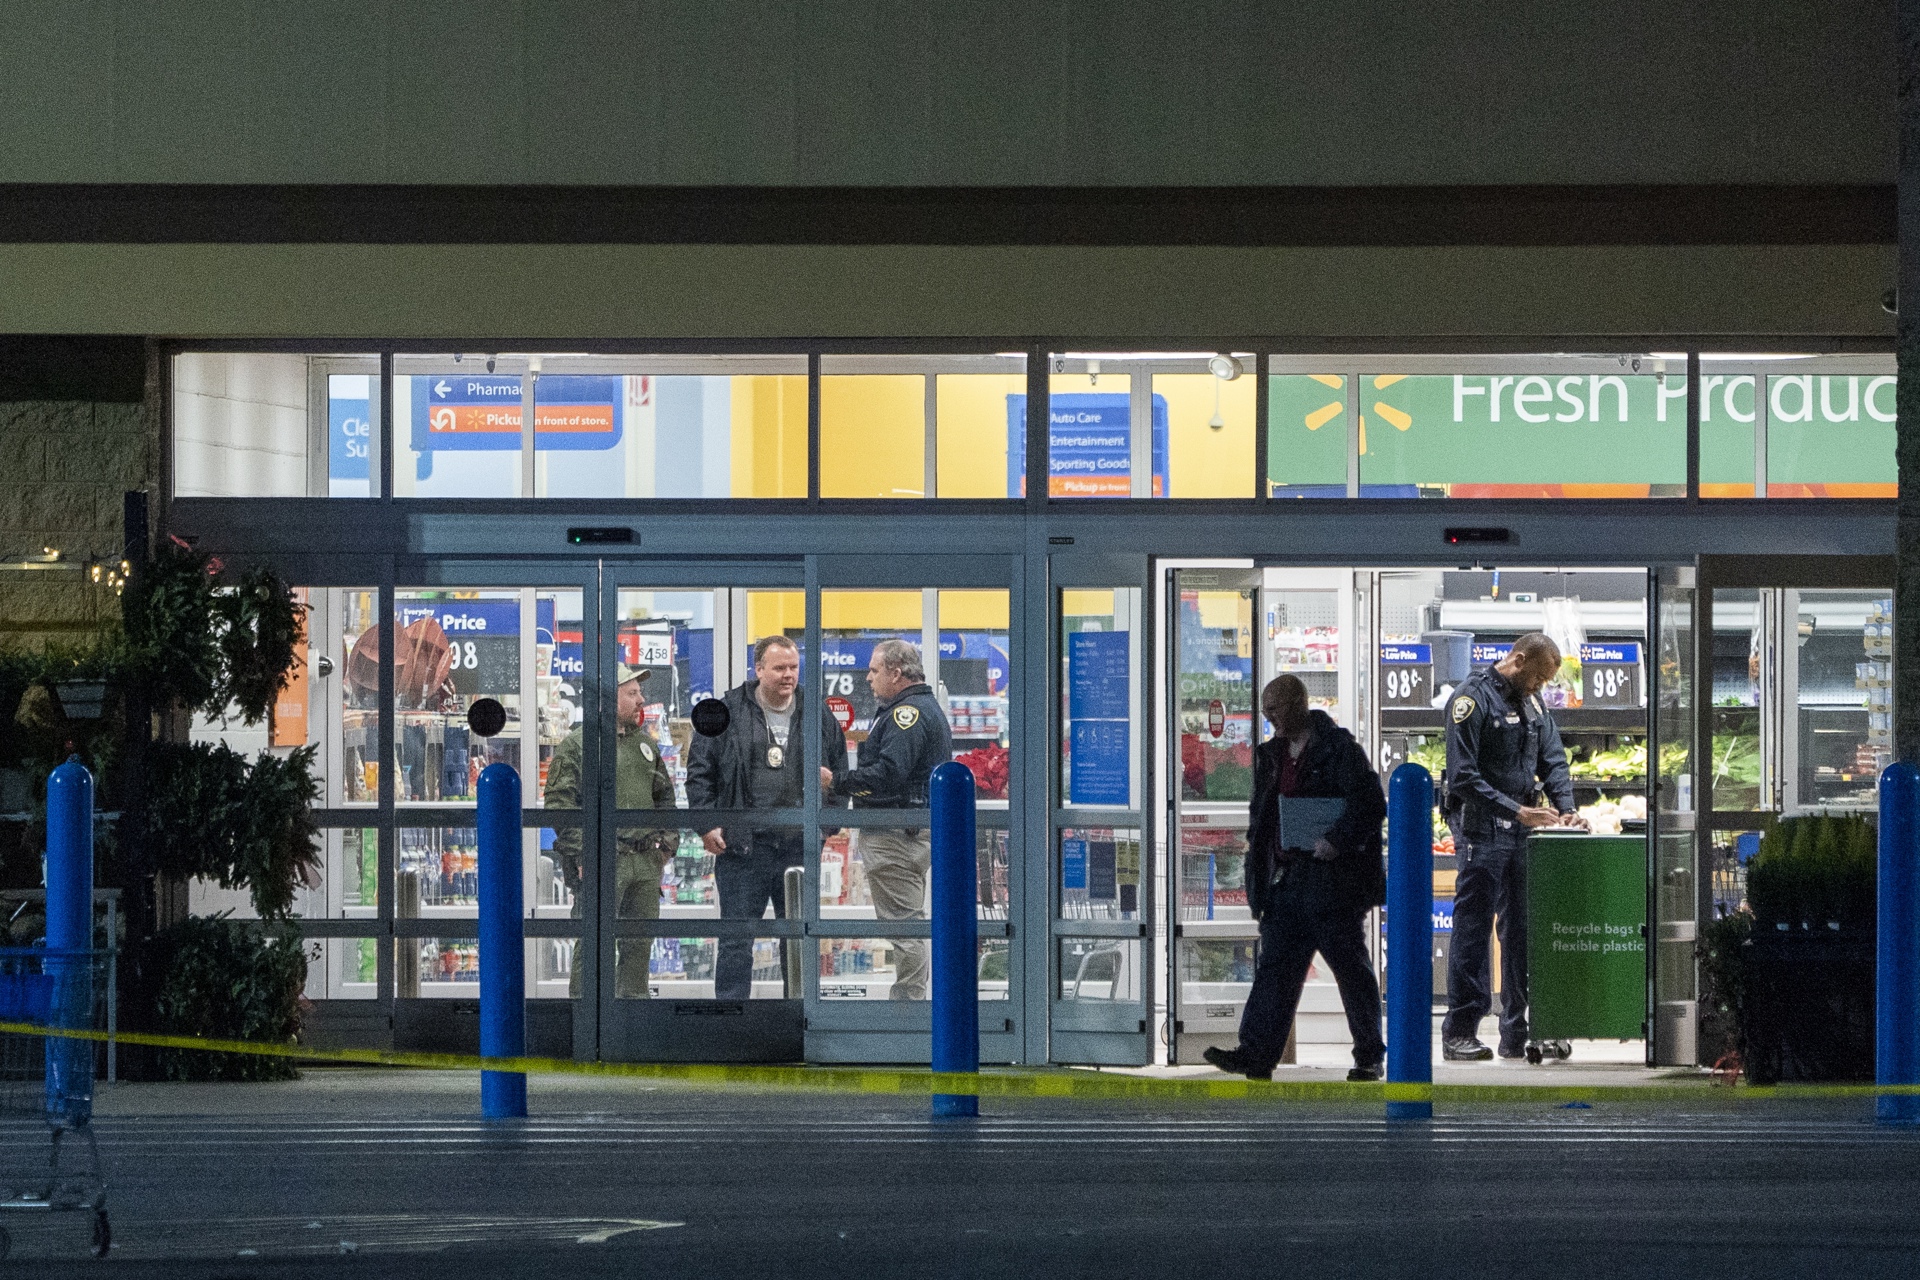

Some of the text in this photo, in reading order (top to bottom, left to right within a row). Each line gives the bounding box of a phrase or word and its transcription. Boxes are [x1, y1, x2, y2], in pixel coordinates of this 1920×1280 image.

[1453, 374, 1898, 423] Fresh Produc
[486, 413, 524, 426] Picku
[543, 415, 568, 426] front
[569, 415, 580, 425] of
[581, 416, 609, 426] store.
[1050, 413, 1102, 424] Auto Care
[342, 418, 370, 437] Cle
[345, 439, 368, 458] Su
[1050, 435, 1125, 447] Entertainment
[1050, 458, 1096, 471] Sporting
[1064, 481, 1098, 494] Pickup
[442, 614, 487, 630] Price
[821, 652, 856, 666] Price
[1498, 650, 1509, 660] Pri
[824, 673, 854, 696] 78
[1552, 922, 1601, 938] Recycle
[1604, 923, 1634, 937] bags
[1552, 939, 1646, 955] flexible plastic
